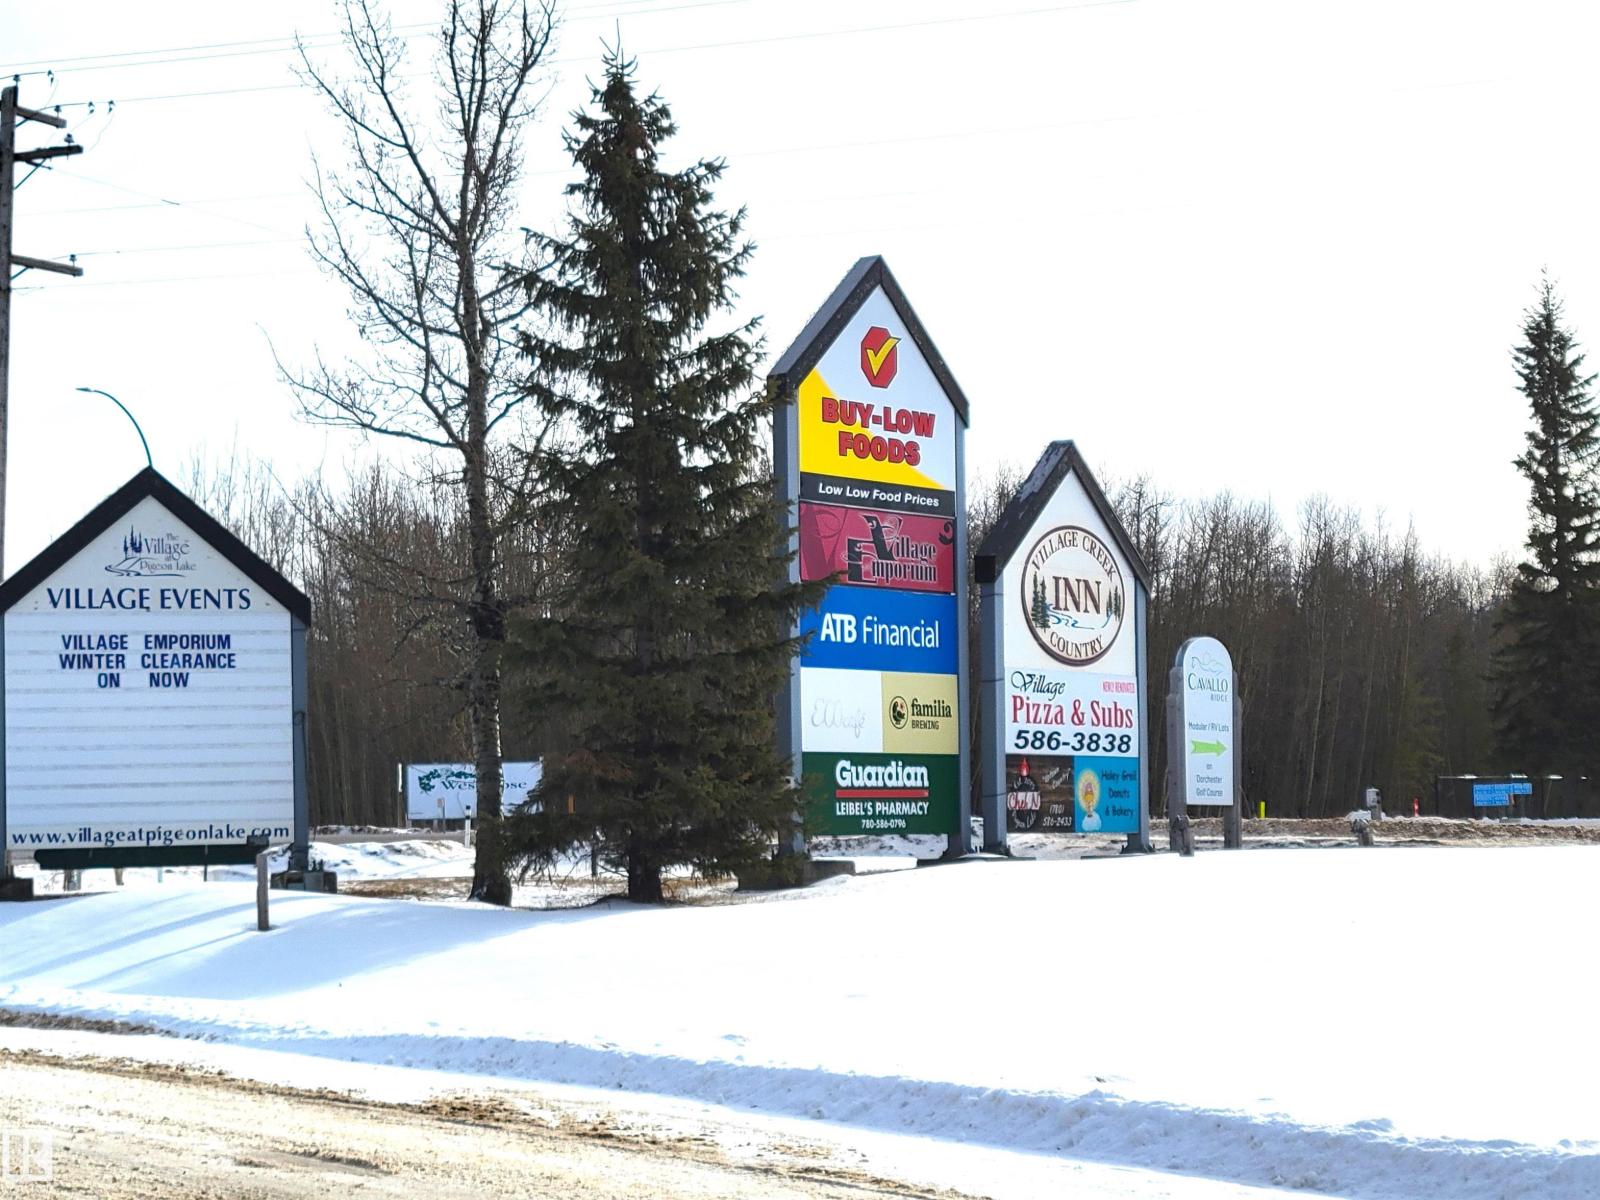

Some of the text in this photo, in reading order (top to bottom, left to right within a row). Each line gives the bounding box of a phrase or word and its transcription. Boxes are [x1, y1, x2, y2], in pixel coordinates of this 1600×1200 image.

[822, 397, 936, 438] BUY-LOW
[838, 431, 921, 466] FOODS
[818, 482, 940, 507] Low Low Food Prices
[144, 537, 190, 560] Village
[860, 513, 937, 563] Village
[140, 561, 197, 573] Pigeon Lake
[845, 537, 937, 585] Emporium
[1032, 531, 1116, 583] VILLAGE CREEK
[47, 587, 251, 610] VILLAGE EVENTS
[1052, 576, 1101, 614] INN
[61, 634, 231, 650] VILLAGE EMPORIUM
[820, 612, 940, 648] ATB Financial
[1050, 631, 1103, 658] COUNTRY
[59, 653, 236, 669] WINTER CLEARANCE
[97, 672, 189, 688] ON NOW
[1011, 670, 1066, 701] Village
[911, 698, 952, 718] familia
[1011, 695, 1134, 728] Pizza & Subs
[911, 720, 940, 730] BREWING
[1014, 729, 1132, 753] 586-3838
[835, 760, 930, 787] Guardian
[836, 801, 930, 816] LEIBEL'S PHARMACY
[12, 823, 289, 847] www.villageatpigeonlakecom
[861, 819, 906, 829] 780-586-0796
